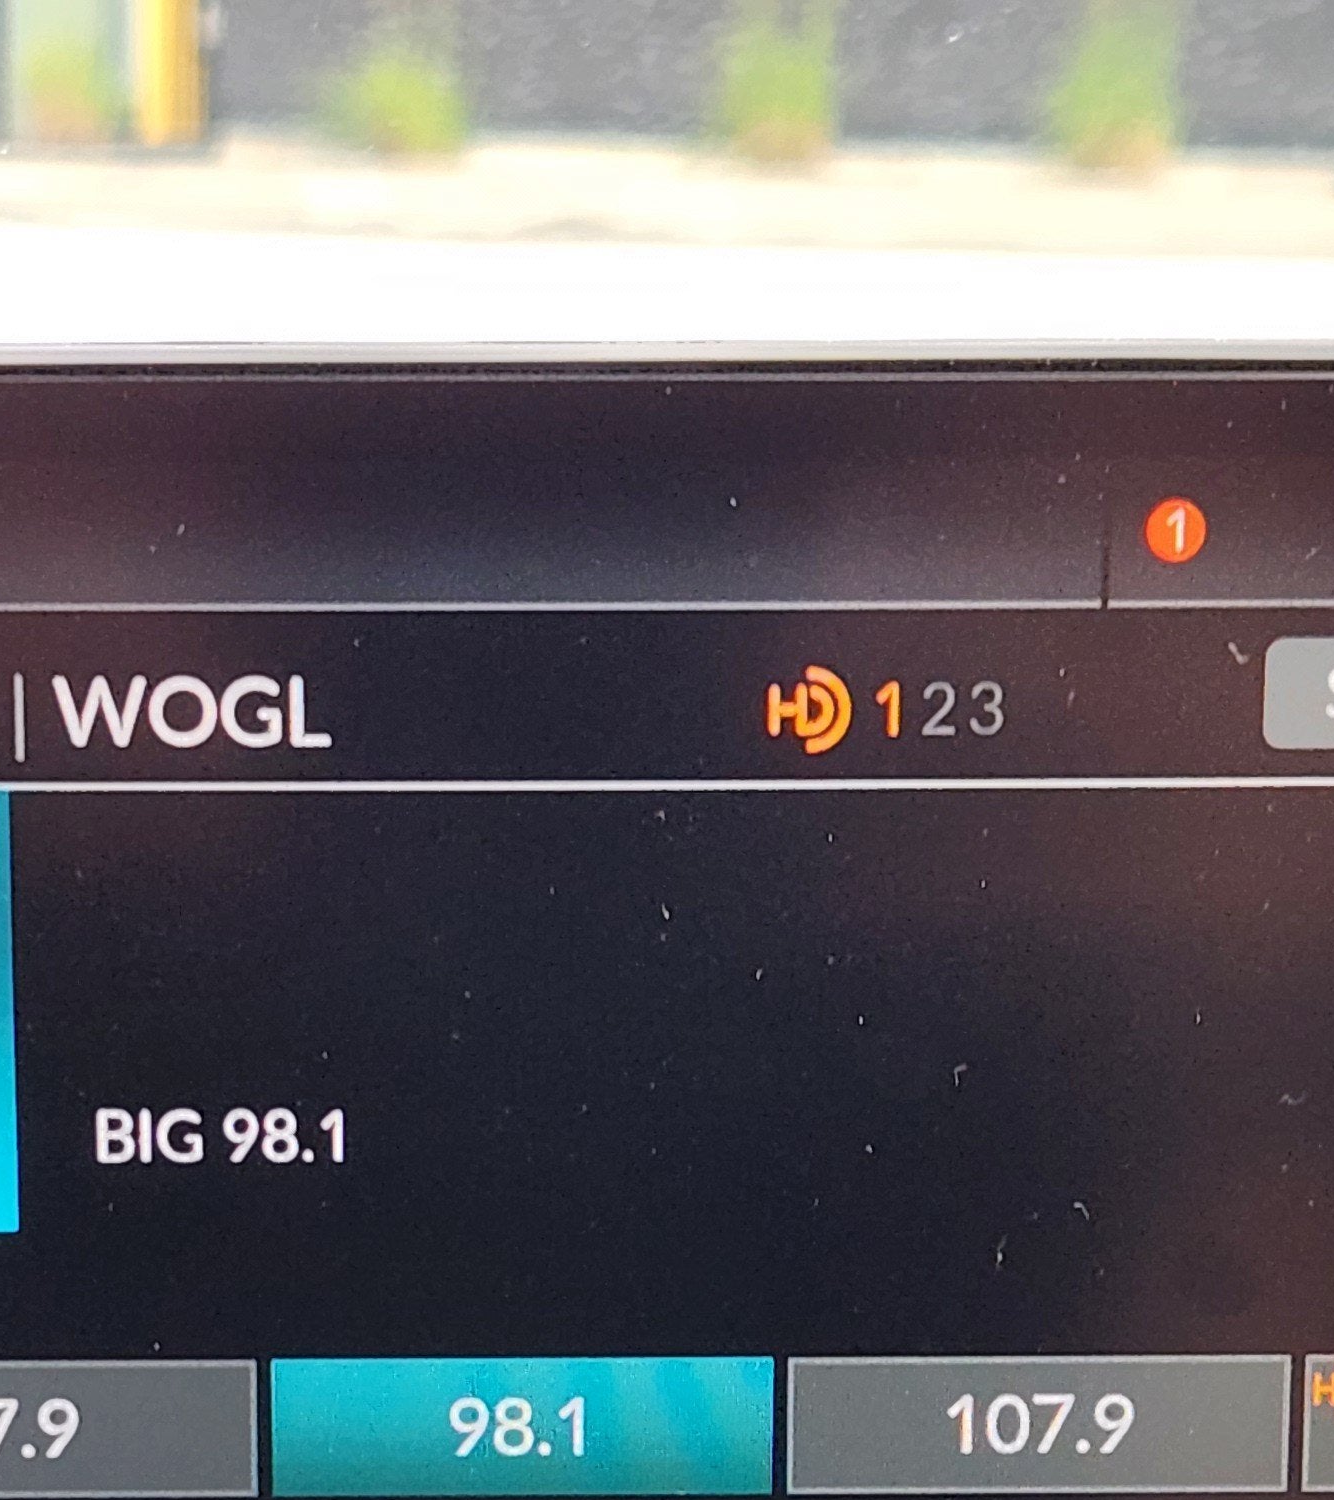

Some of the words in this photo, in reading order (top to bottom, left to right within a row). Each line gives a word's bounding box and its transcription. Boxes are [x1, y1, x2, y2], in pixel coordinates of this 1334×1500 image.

[1165, 506, 1188, 555] 1
[51, 674, 332, 748] WOGL
[95, 1107, 204, 1164] BIG
[222, 1107, 344, 1164] 98.1
[449, 1396, 585, 1457] 98.1
[946, 1393, 1135, 1455] 107.9
